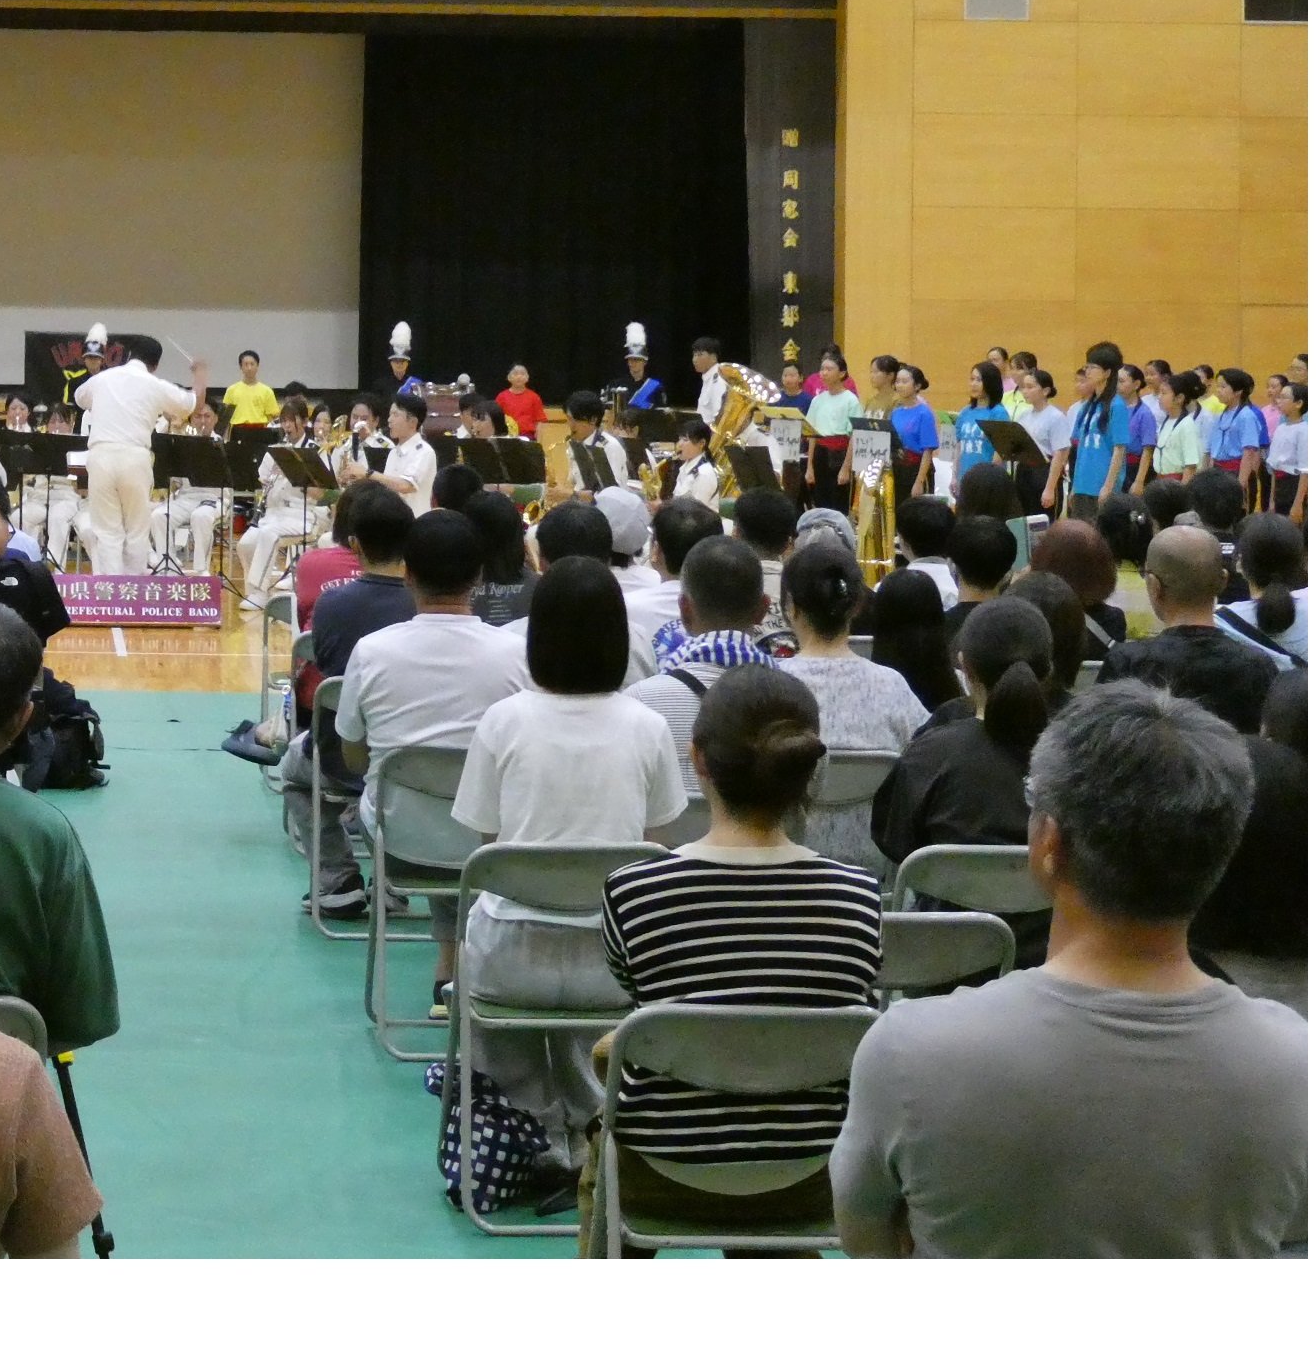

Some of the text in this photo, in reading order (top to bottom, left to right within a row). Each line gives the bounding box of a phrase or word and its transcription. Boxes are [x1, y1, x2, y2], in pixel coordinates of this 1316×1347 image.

[65, 606, 218, 617] REFECTURAL POLICE BAND
